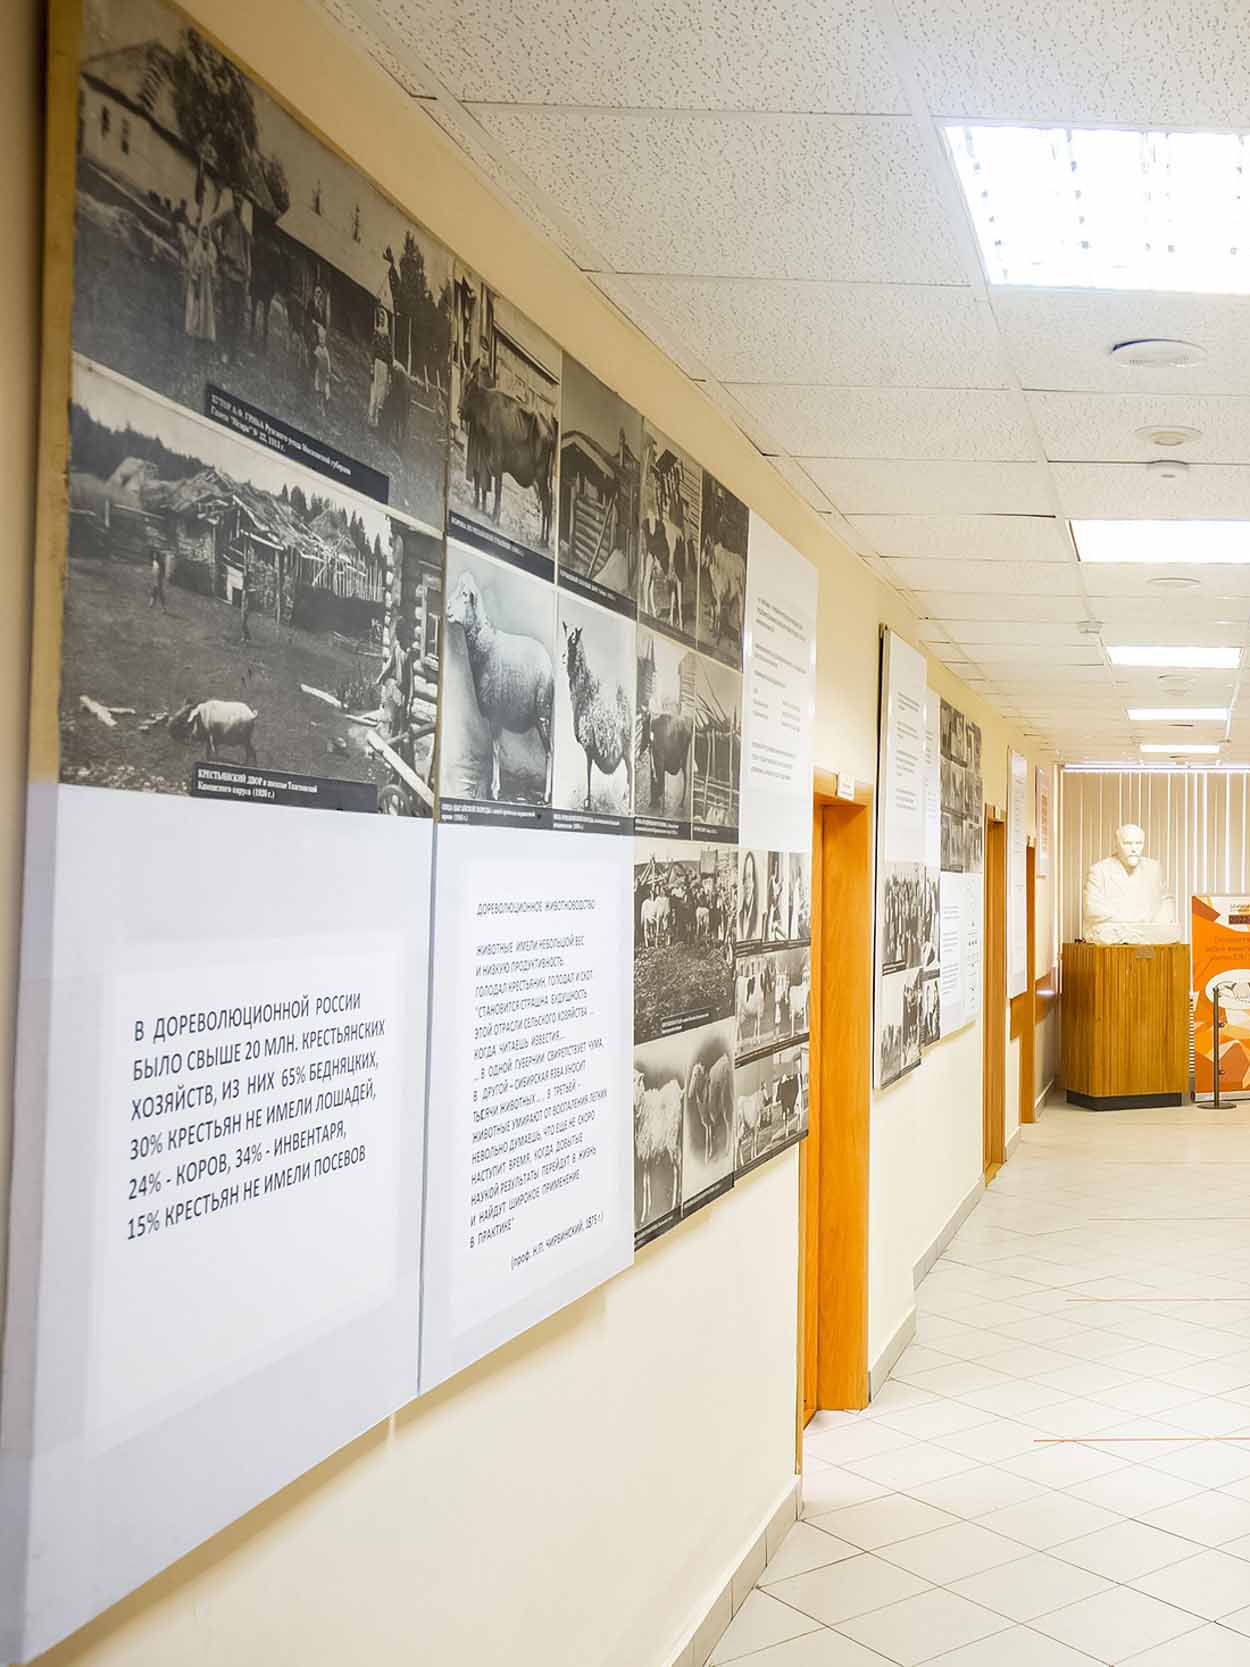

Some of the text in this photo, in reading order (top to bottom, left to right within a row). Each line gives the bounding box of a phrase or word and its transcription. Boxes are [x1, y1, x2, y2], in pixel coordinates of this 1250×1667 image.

[477, 899, 595, 915] ДОРЕВОЛЮЦИОННОЕ ЖИВОТНОВОДСТВО
[476, 933, 584, 956] ЖИВОТНЫЕ ИМЕЛИ НЕБОЛЬШОЙ ВЕС
[475, 982, 506, 998] ГОЛОДАЛ
[547, 972, 575, 986] ГОЛОДАЛ
[482, 962, 510, 976] НИЗКУЮ
[520, 994, 548, 1011] СТРАШНА
[551, 988, 587, 1005] БУДУЩНОСТЬ
[134, 993, 361, 1044] В ДОРЕВОЛЮЦИОННОЙ РОССИИ
[475, 1023, 492, 1040] ЭТОЙ
[494, 1019, 523, 1036] ОТРАСЛИ
[523, 1012, 557, 1030] СЕЛЬСКОГО
[557, 1006, 587, 1022] ХОЗЯЙСТВА
[133, 1019, 385, 1081] БЫЛО СВЫШЕ 20 МЛН. КРЕСТЬЯНСКИХ
[474, 1045, 496, 1060] КОГДА
[499, 1038, 529, 1054] ЧИТАЕШЬ
[488, 1058, 513, 1078] ОДНОЙ
[514, 1053, 545, 1070] ГУБЕРНИИ
[547, 1041, 587, 1062] СВИРЕПСТВУЕТ
[130, 1050, 378, 1121] ХОЗЯЙСТВ, ИЗ НИХ 65% БЕДНЯЦКИХ,
[482, 1080, 509, 1100] ДРУГОЙ
[514, 1070, 549, 1091] СИБИРСКАЯ
[129, 1077, 377, 1160] 30% КРЕСТЬЯН НЕ ИМЕЛИ ЛОШАДЕЙ,
[472, 1122, 510, 1144] ЖИВОТНЫЕ
[511, 1109, 543, 1130] УМИРАЮТ
[473, 1105, 499, 1123] ТЫСЯЧИ
[128, 1170, 162, 1200] 24%
[176, 1154, 232, 1186] КОРОВ,
[235, 1143, 263, 1168] 34%
[274, 1120, 347, 1157] ИНВЕНТАРЯ,
[471, 1161, 507, 1185] НАСТУПИТ
[534, 1144, 554, 1160] КОГДА
[472, 1140, 508, 1165] НЕВОЛЬНО
[127, 1145, 366, 1240] 15% КРЕСТЬЯН НЕ ИМЕЛИ ПОСЕВОВ
[471, 1181, 499, 1207] НАУКОЙ
[500, 1168, 540, 1193] РЕЗУЛЬТАТЫ
[541, 1154, 570, 1176] ПЕРЕЙДУТ
[479, 1201, 507, 1224] НАЙДУТ
[508, 1185, 540, 1210] ШИРОКОЕ
